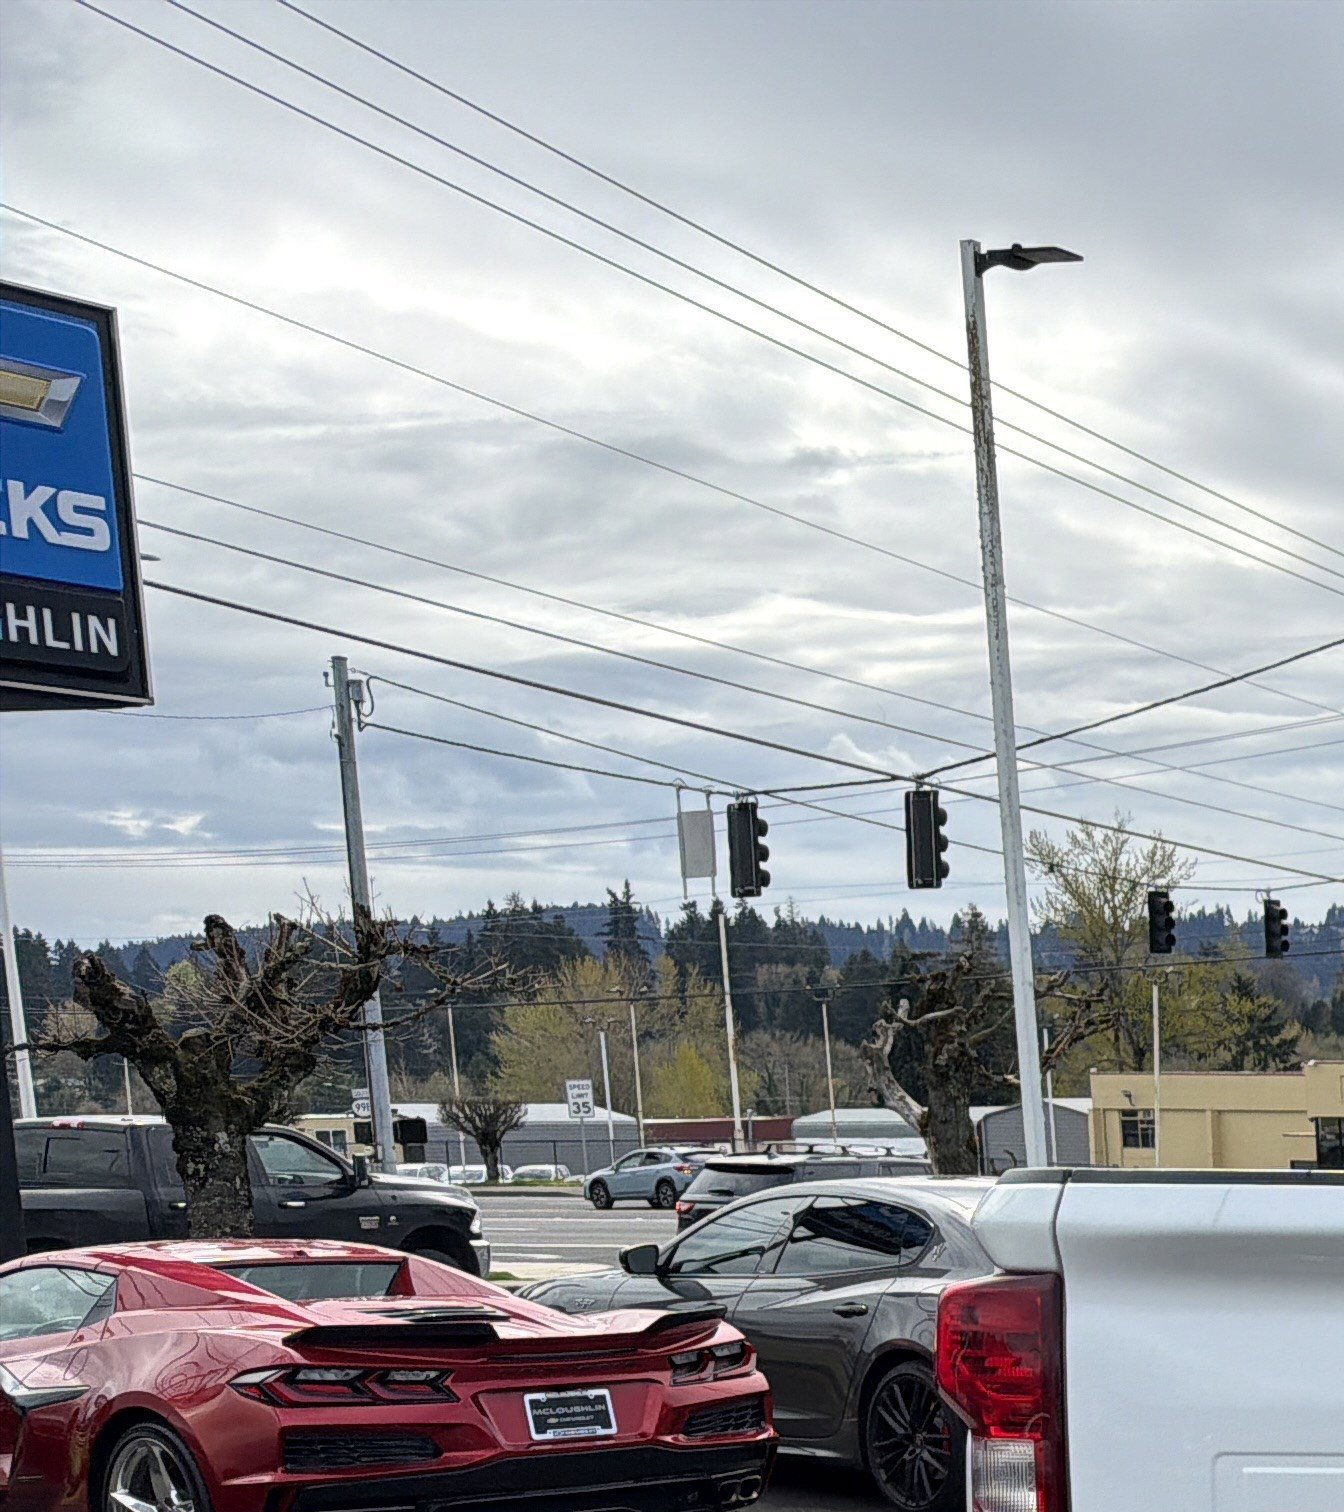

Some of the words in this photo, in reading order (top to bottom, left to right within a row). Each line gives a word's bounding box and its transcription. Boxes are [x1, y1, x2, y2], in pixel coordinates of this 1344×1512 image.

[0, 479, 110, 551] KS
[0, 602, 119, 656] HLIN
[568, 1083, 591, 1091] SPEED
[570, 1092, 589, 1100] LIMIT
[571, 1101, 592, 1115] 35
[532, 1404, 607, 1416] MCLOUGHLIN
